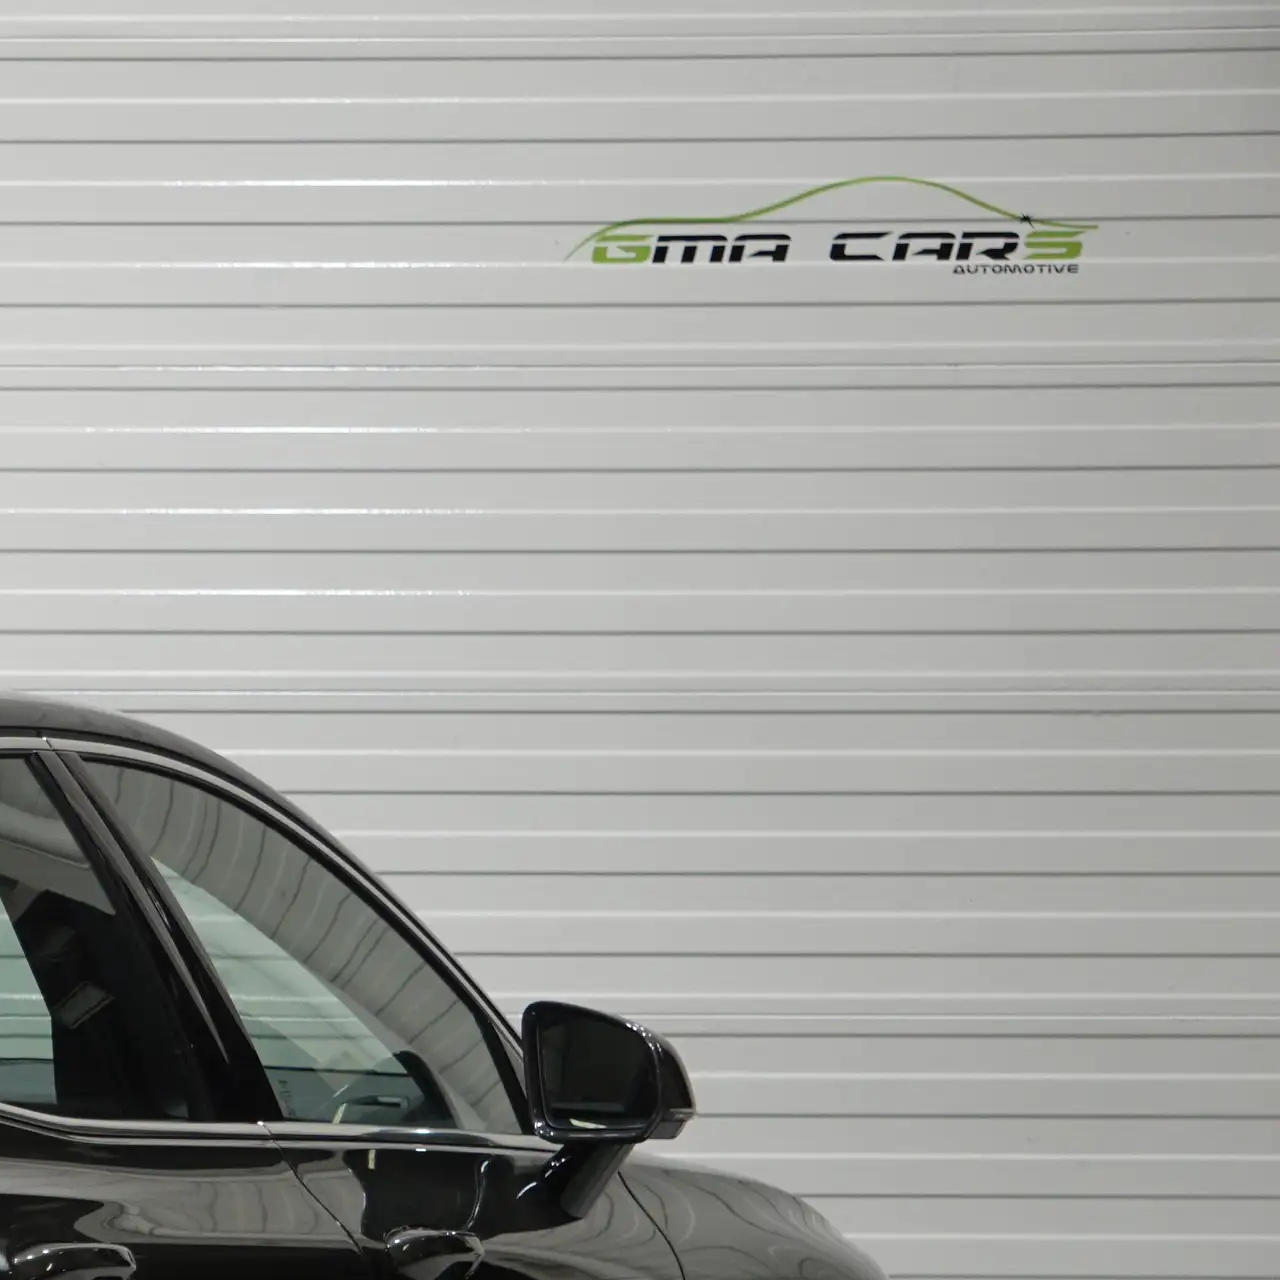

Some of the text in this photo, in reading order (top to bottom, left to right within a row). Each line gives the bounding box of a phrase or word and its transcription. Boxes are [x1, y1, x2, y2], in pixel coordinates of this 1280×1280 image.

[592, 231, 1086, 264] GMA CARS
[953, 263, 1080, 275] AUTOMOTIVE
